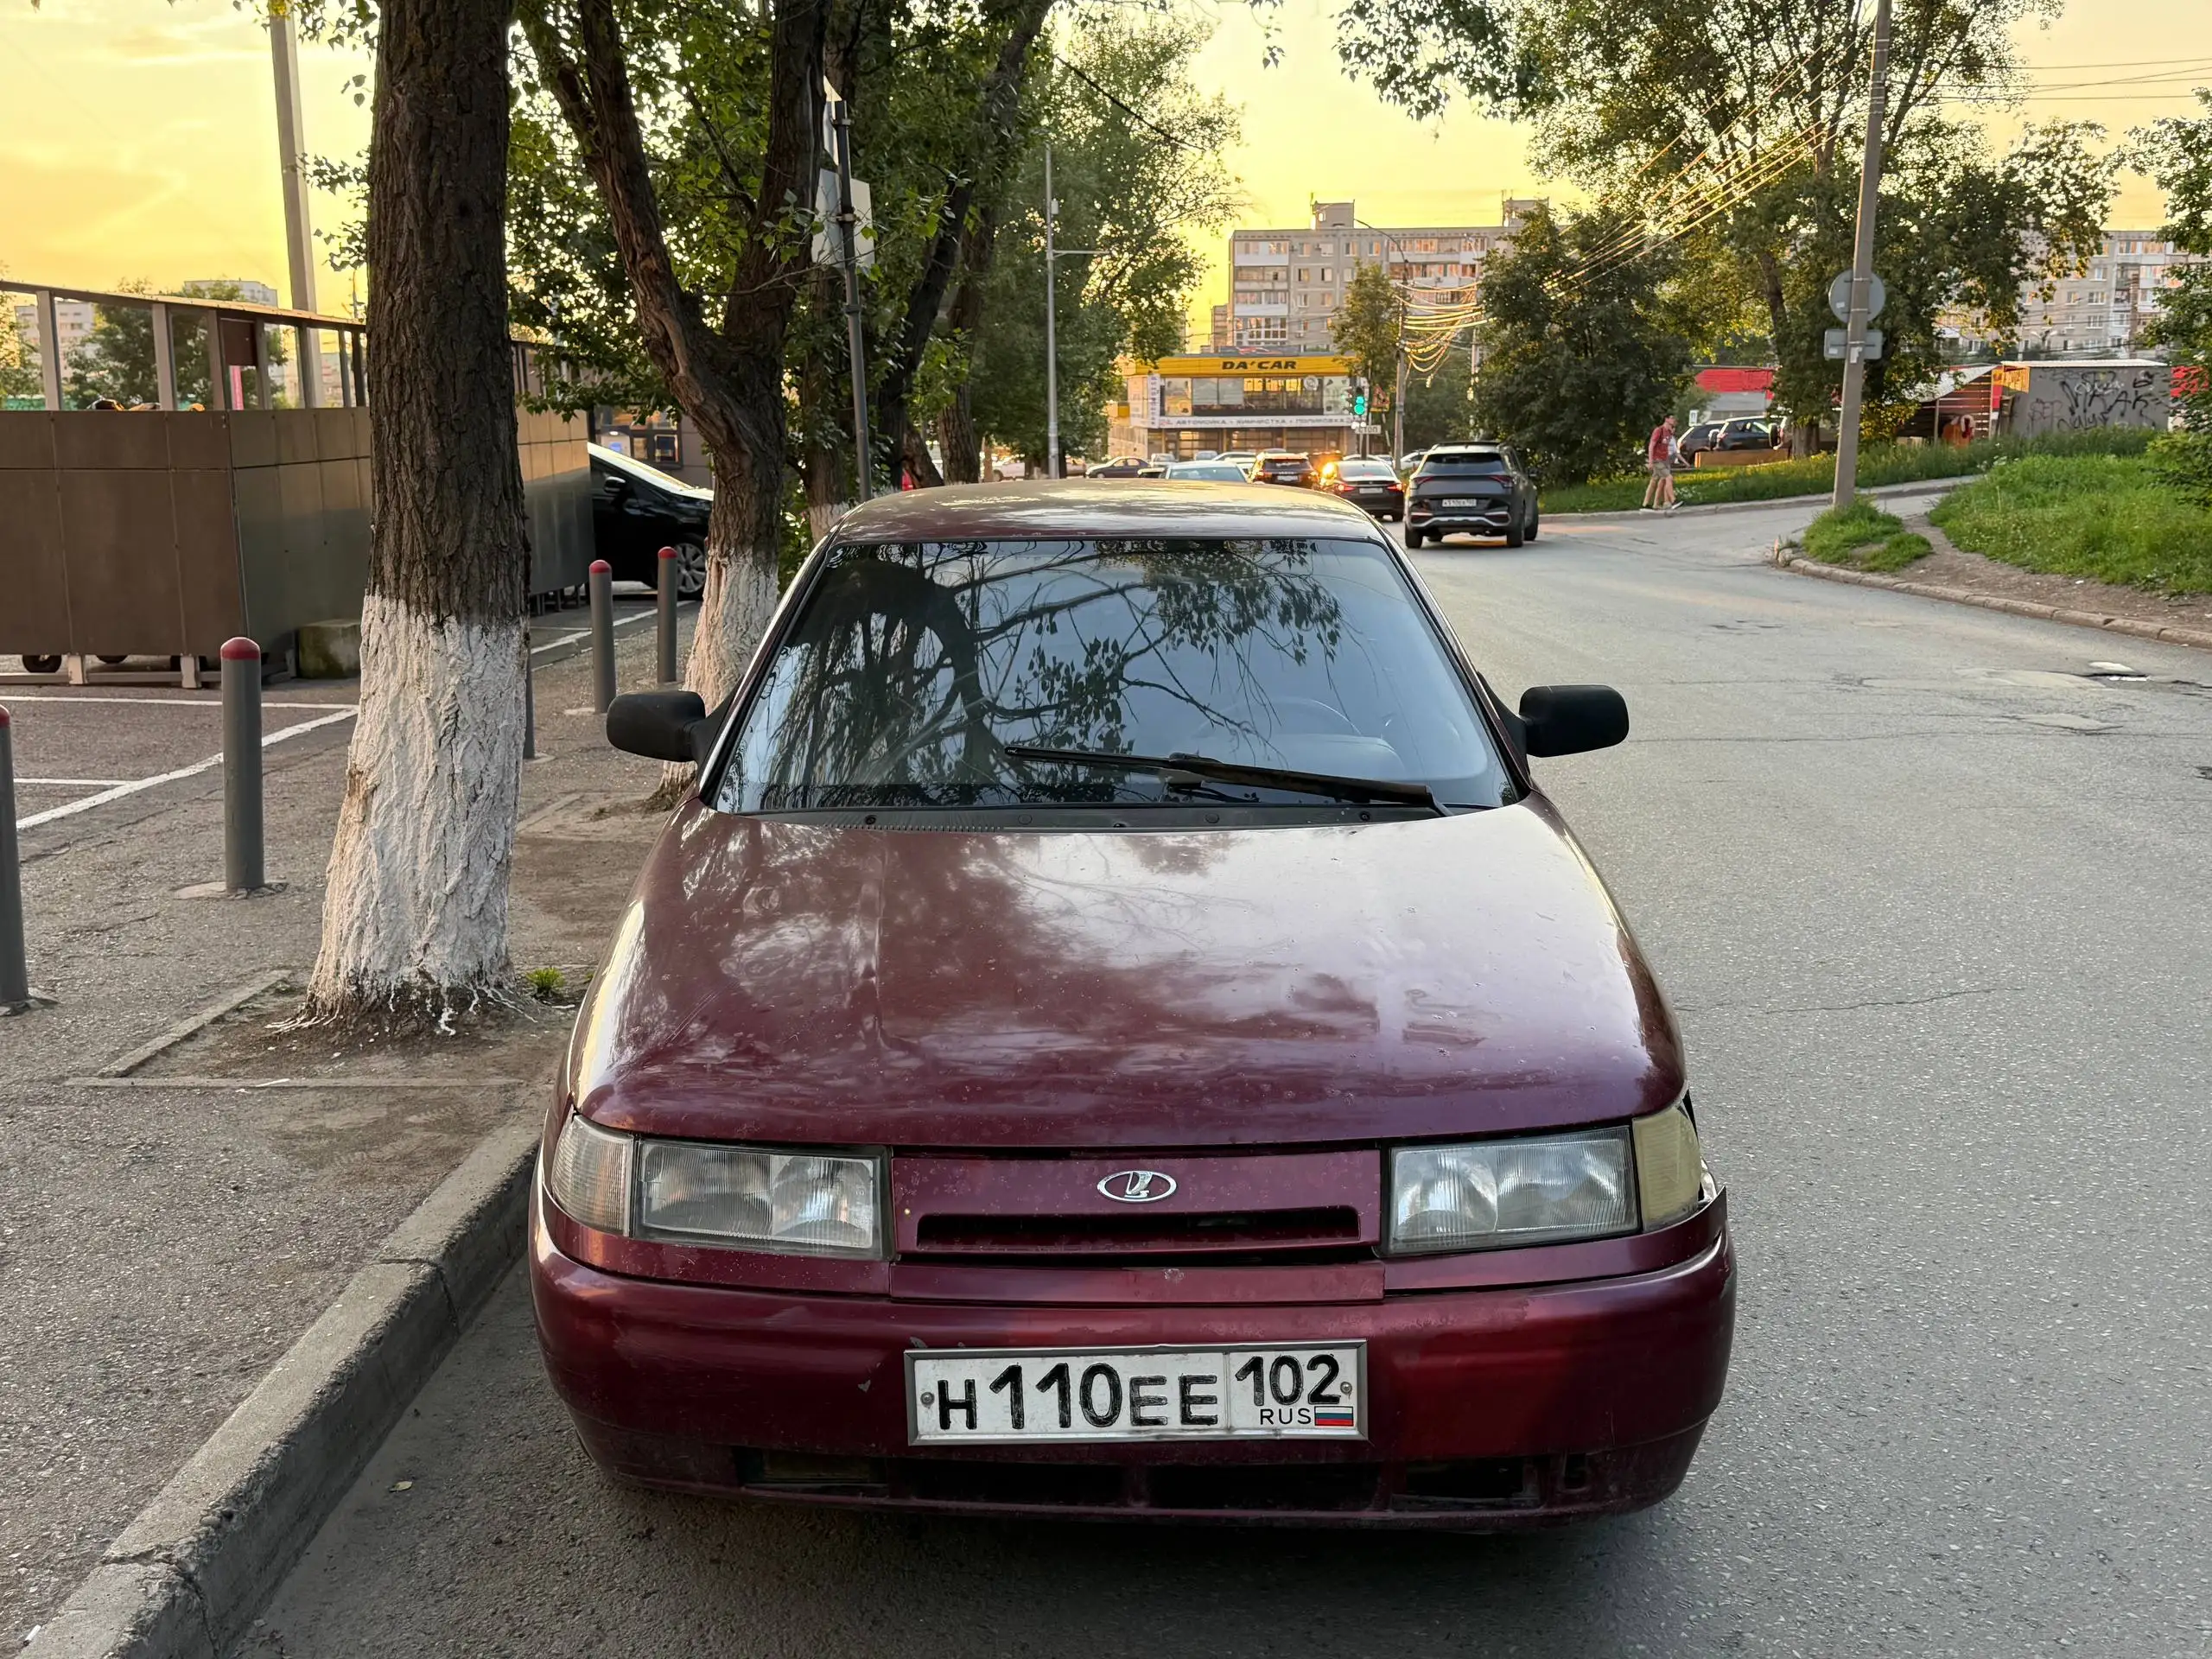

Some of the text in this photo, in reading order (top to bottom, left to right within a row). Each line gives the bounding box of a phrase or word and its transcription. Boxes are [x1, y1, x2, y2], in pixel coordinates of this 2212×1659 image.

[1222, 360, 1297, 370] DA'CAR
[1235, 1354, 1340, 1407] 102
[1260, 1407, 1313, 1426] RUS
